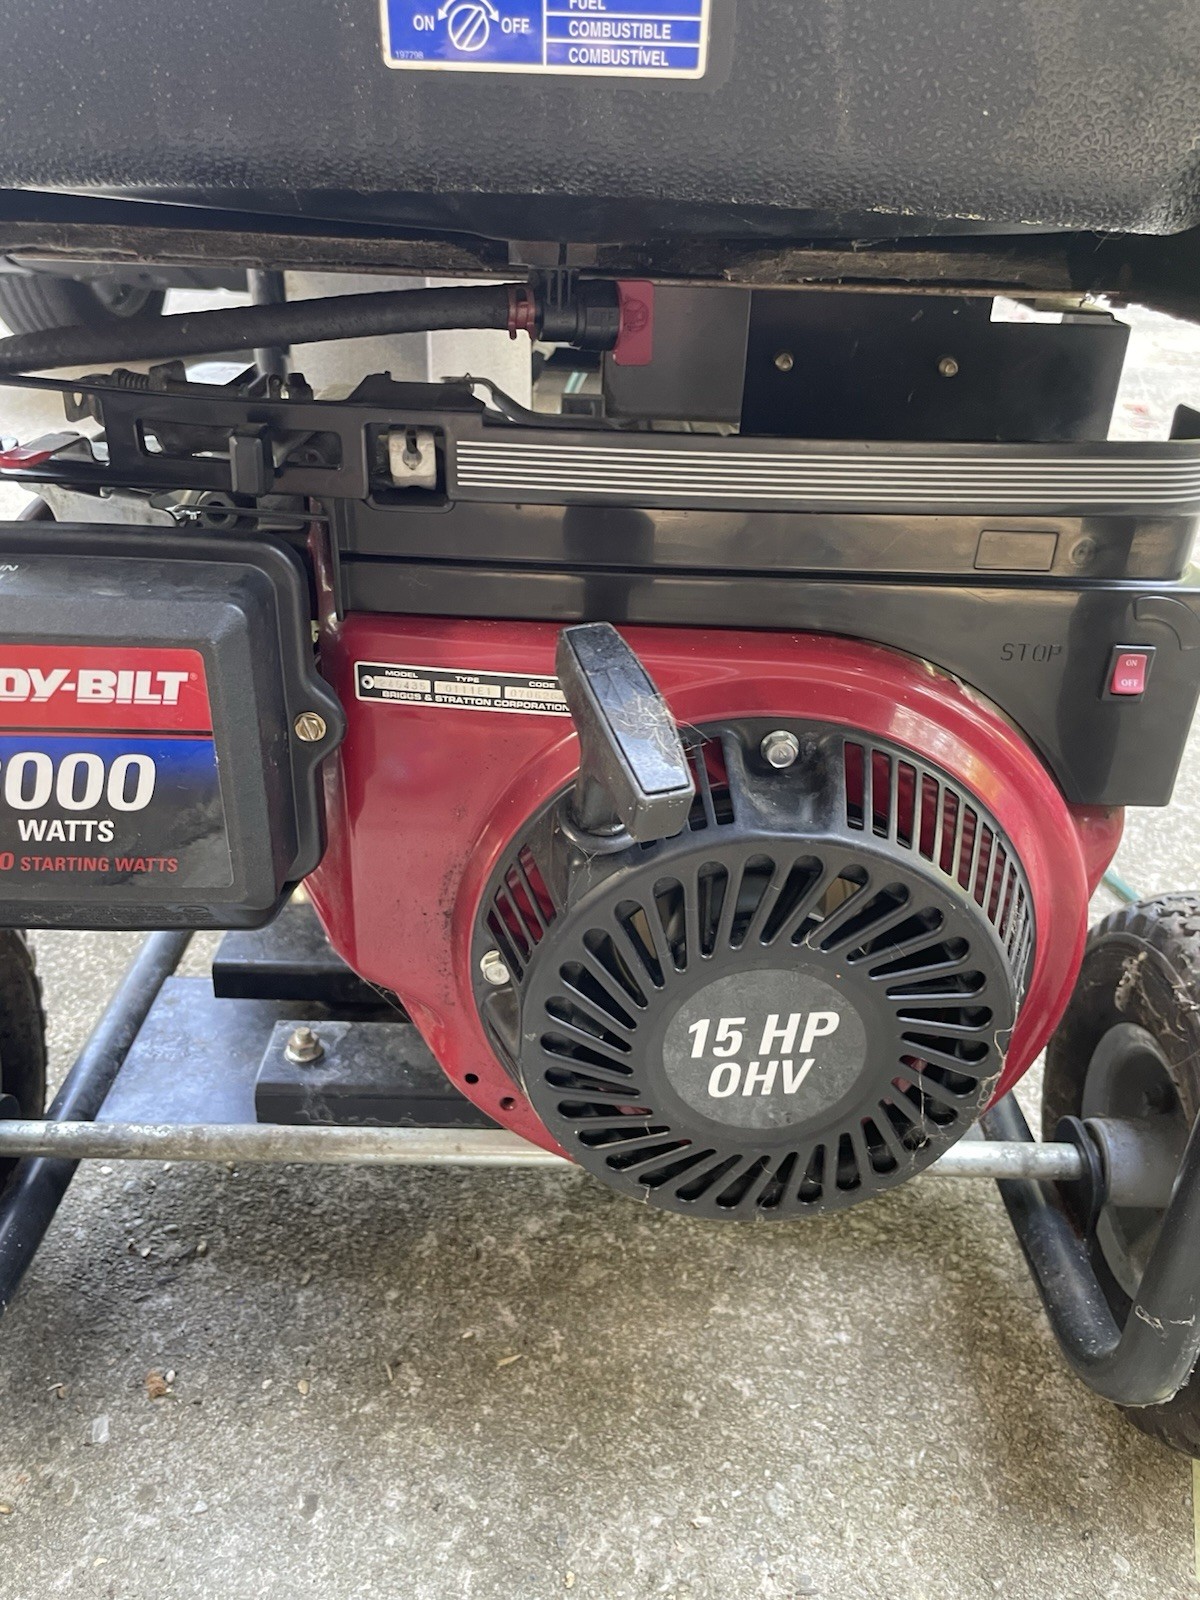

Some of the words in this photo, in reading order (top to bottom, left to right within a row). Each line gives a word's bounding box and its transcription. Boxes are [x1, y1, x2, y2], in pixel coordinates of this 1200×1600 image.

[569, 0, 606, 10] FUEL
[413, 15, 434, 31] ON
[501, 17, 529, 34] OFF
[568, 20, 672, 40] COMBUSTIBLE
[568, 46, 669, 67] COMBUSTÍVEL
[1000, 642, 1062, 662] STOP
[1126, 659, 1138, 667] ON
[385, 669, 419, 679] MODEL
[455, 675, 480, 683] TYPE
[528, 681, 556, 689] CODE
[1121, 679, 1139, 687] OFF
[382, 690, 422, 701] BRIGGS
[425, 694, 433, 703] &
[435, 695, 492, 707] STRATTON
[494, 700, 570, 712] CORPORATION
[0, 752, 156, 811] 000
[18, 819, 116, 842] WATTS
[20, 856, 109, 872] STARTING
[115, 857, 178, 872] WATTS
[688, 1017, 747, 1058] 15
[758, 1011, 840, 1055] HP
[708, 1058, 816, 1098] OHV
